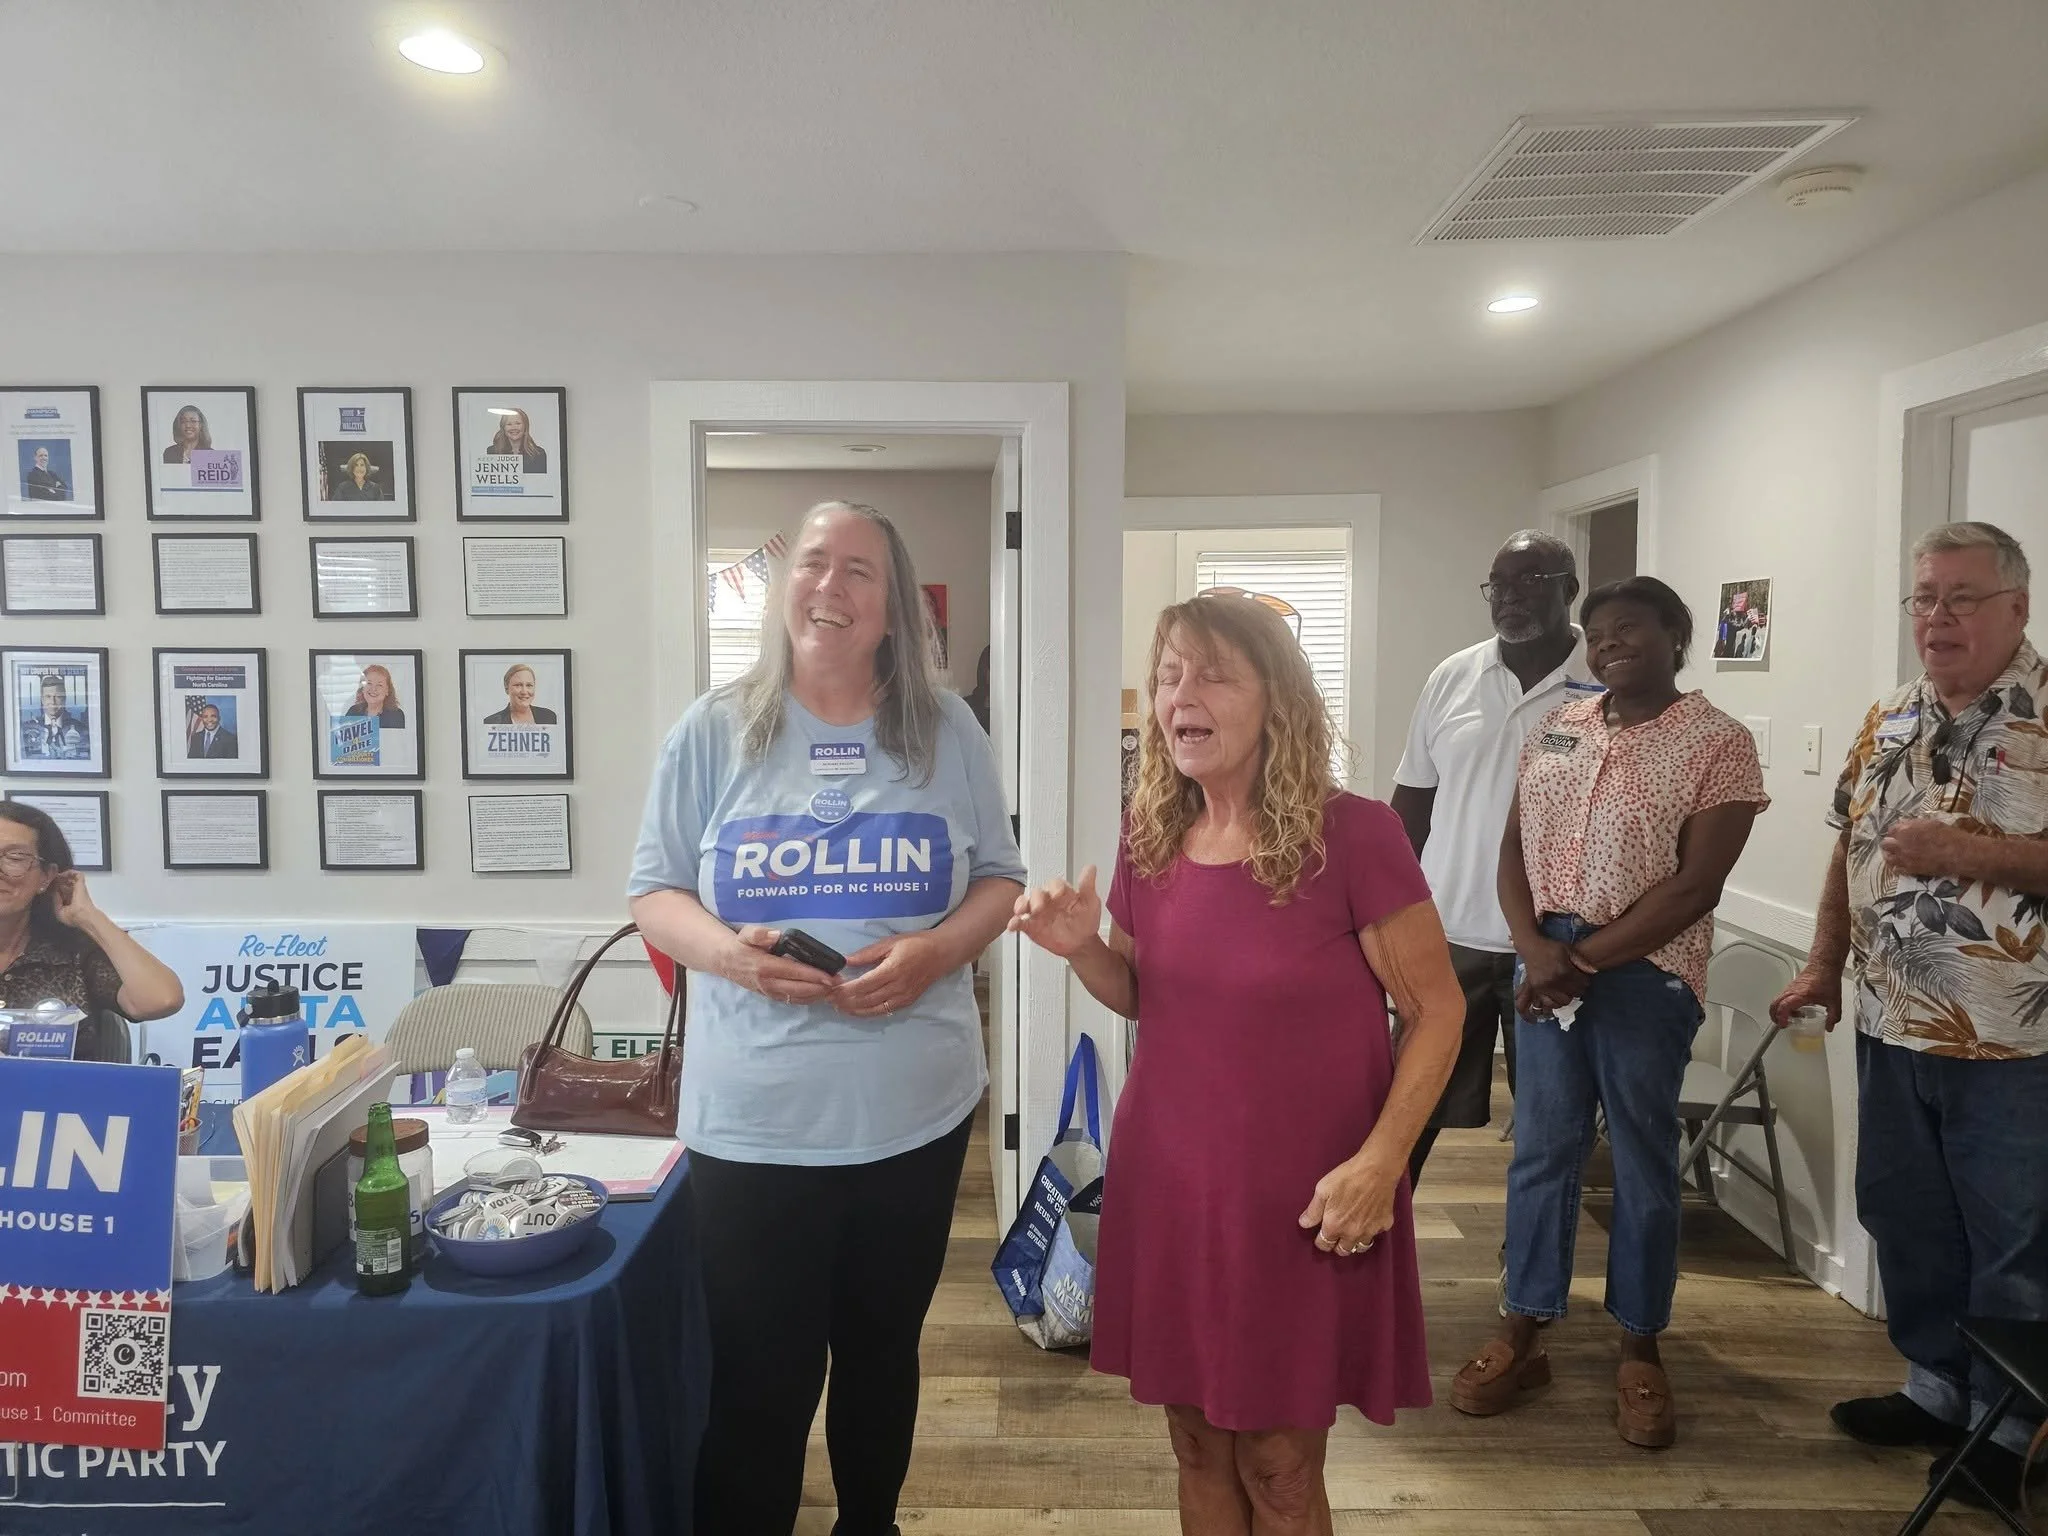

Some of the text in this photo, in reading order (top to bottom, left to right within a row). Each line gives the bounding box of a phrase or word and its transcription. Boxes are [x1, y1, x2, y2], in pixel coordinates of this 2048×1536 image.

[207, 462, 229, 470] EULA
[475, 463, 519, 473] JENNY
[198, 470, 230, 481] REID
[476, 474, 519, 484] WELLS
[335, 720, 373, 745] NAVEL
[343, 739, 372, 753] DARE
[488, 732, 551, 752] ZEHNER
[1542, 737, 1574, 747] GOVAN
[815, 747, 860, 756] ROLLIN
[815, 799, 847, 807] ROLLIN
[732, 837, 931, 880] ROLLIN
[737, 882, 929, 898] FORWARD FOR NC HOUSE 1
[238, 934, 328, 957] Re-Elect
[202, 962, 363, 993] JUSTICE
[195, 994, 366, 1031] ATA
[16, 1031, 67, 1043] ROLLIN
[0, 1110, 130, 1193] IN
[489, 1194, 517, 1210] VOTE
[1046, 1193, 1056, 1204] OF
[0, 1210, 114, 1235] HOUSE 1
[524, 1213, 557, 1226] OUT
[33, 1406, 43, 1420] 1
[53, 1407, 137, 1427] Committee
[79, 1440, 227, 1478] PARTY
